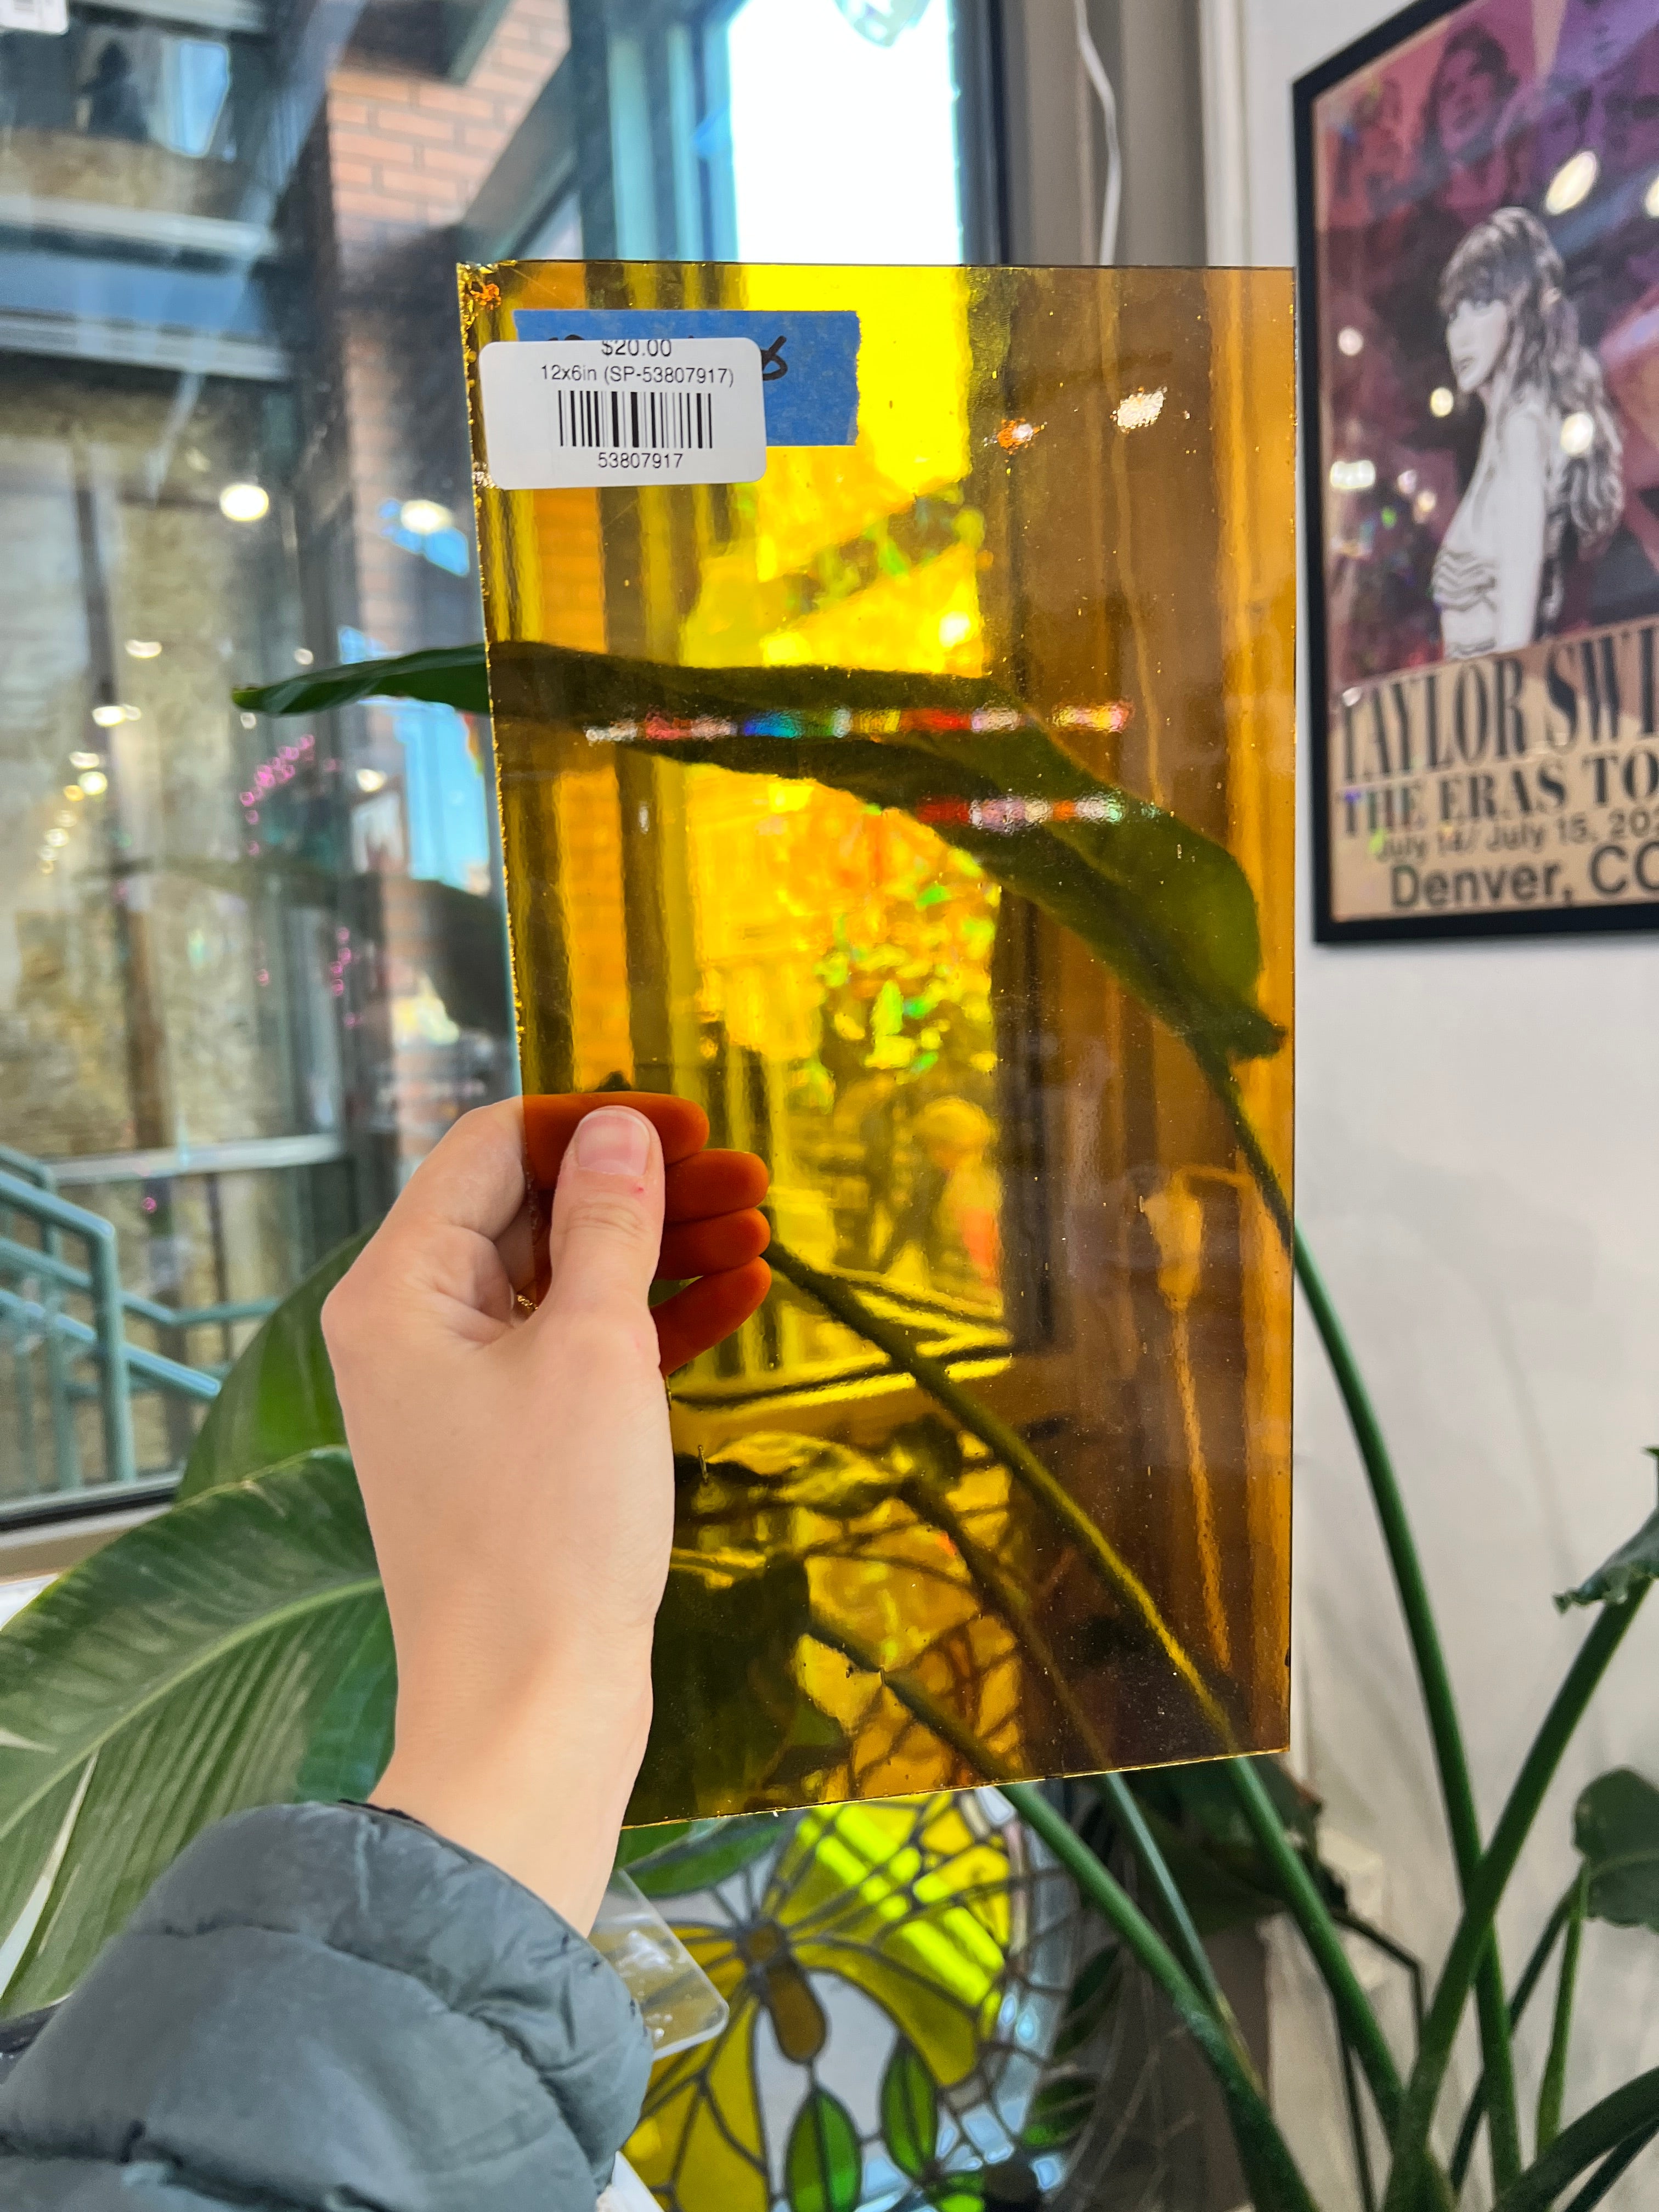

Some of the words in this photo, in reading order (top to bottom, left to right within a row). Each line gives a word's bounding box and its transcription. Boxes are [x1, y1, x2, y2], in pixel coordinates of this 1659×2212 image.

[601, 338, 673, 357] $20.00
[540, 365, 597, 381] 12x6in
[605, 365, 734, 387] (SP-53807917)
[599, 453, 684, 469] 53807917
[1341, 658, 1530, 786] TAYLOR
[1436, 763, 1567, 823] ERAS
[1487, 820, 1544, 854] July
[1391, 860, 1573, 909] Denver,
